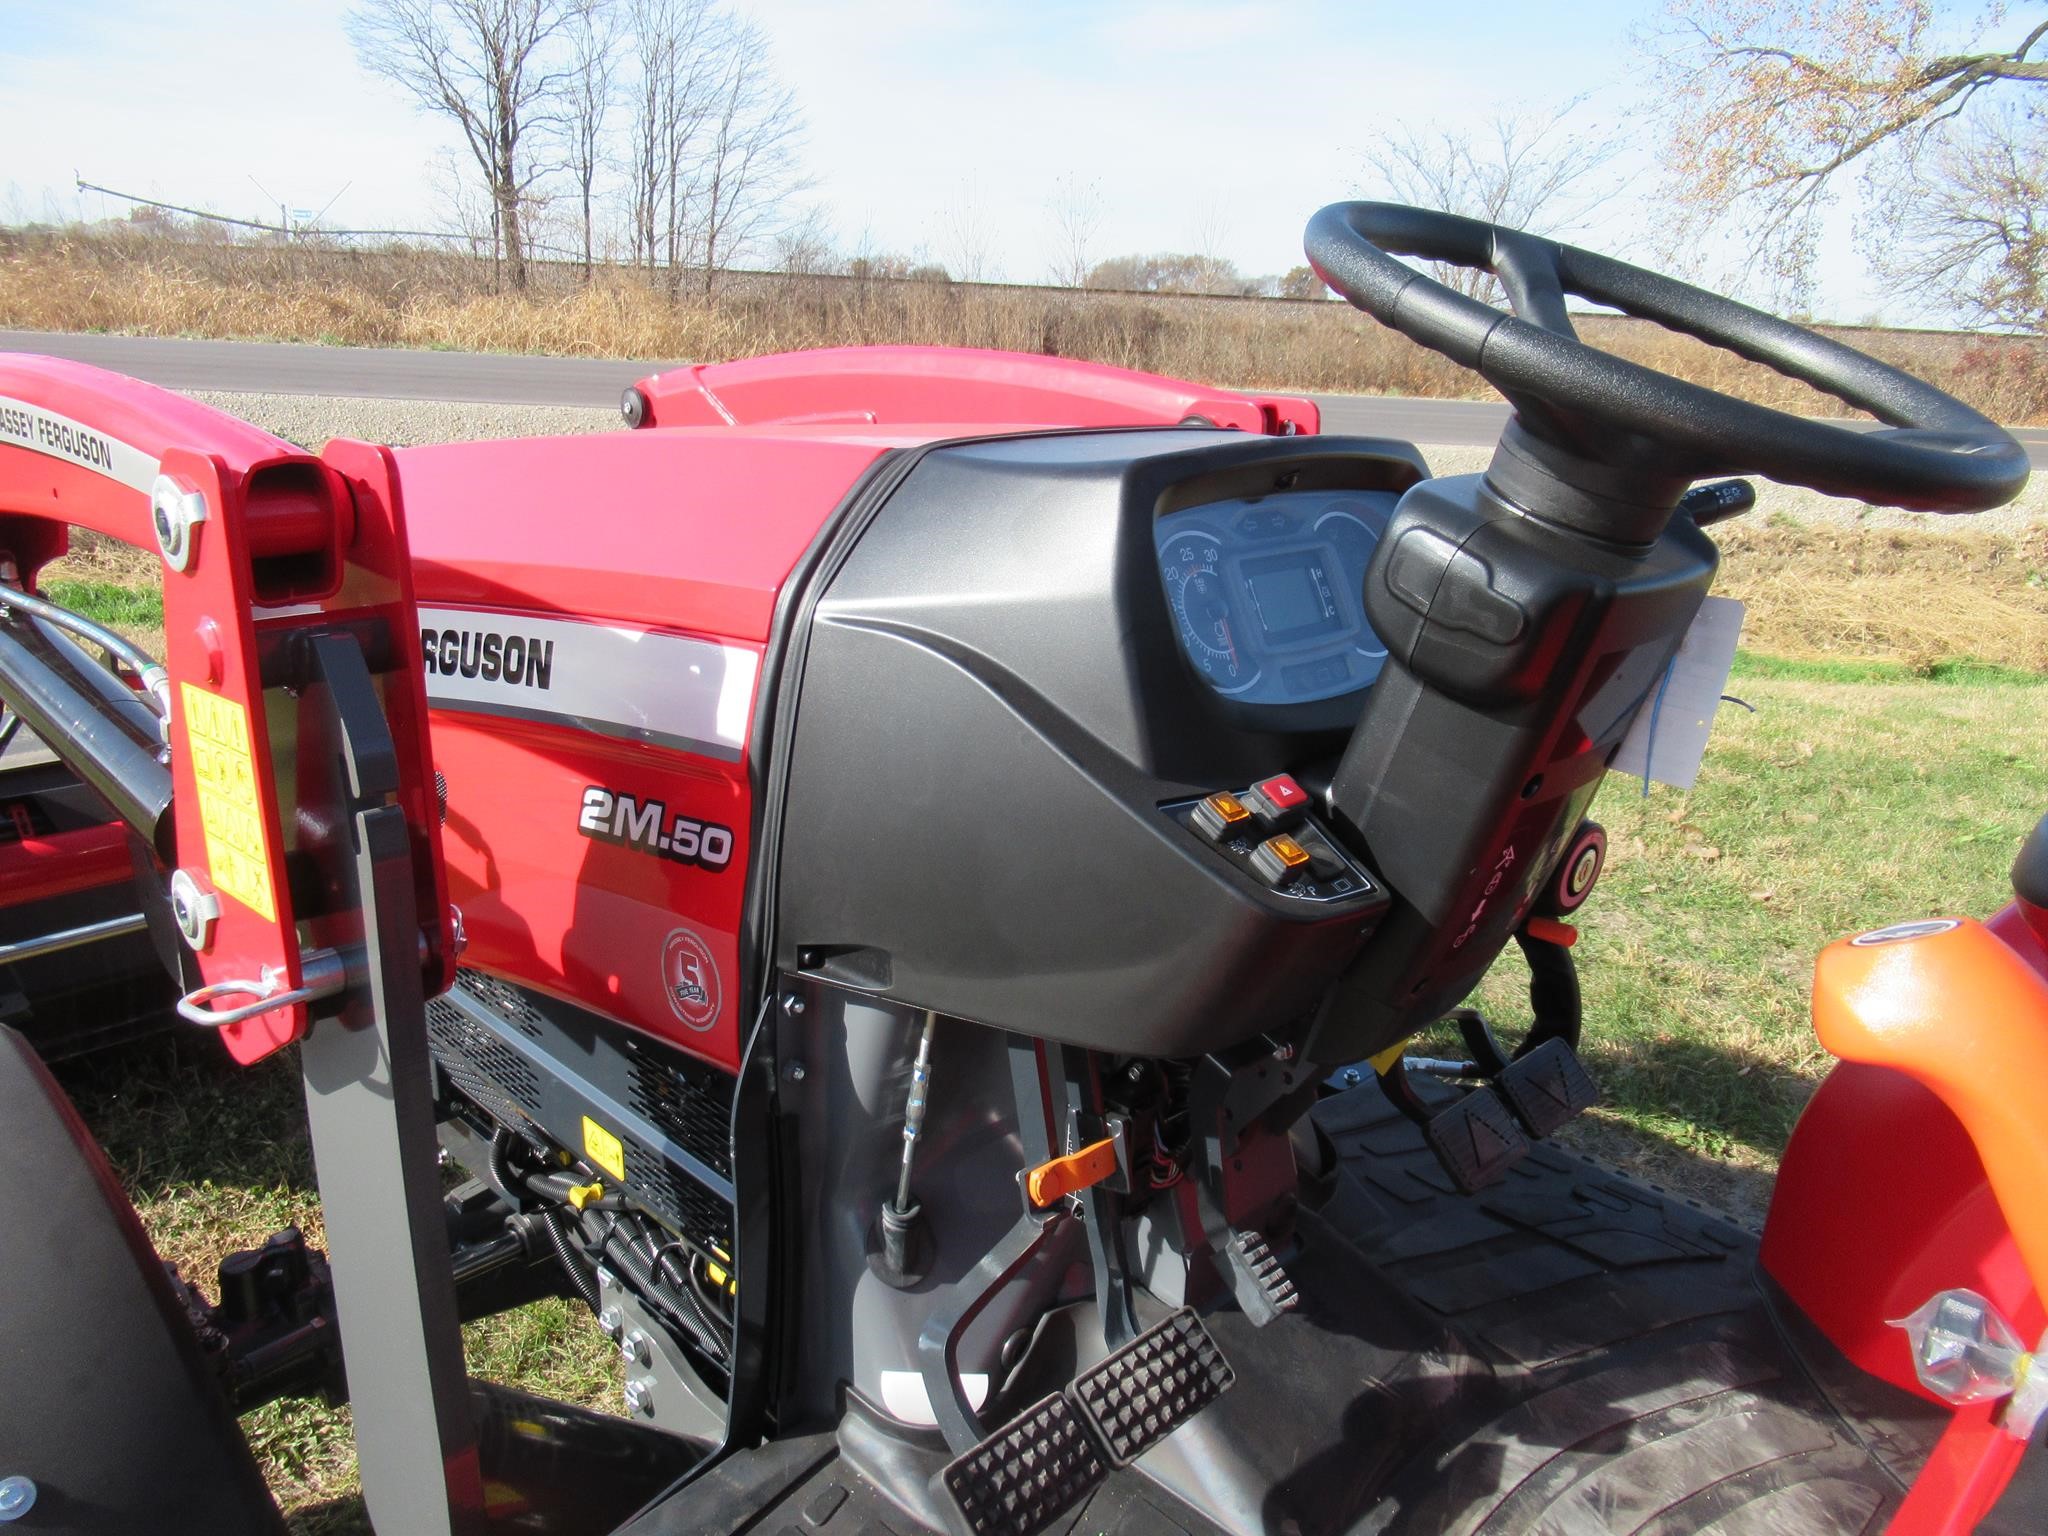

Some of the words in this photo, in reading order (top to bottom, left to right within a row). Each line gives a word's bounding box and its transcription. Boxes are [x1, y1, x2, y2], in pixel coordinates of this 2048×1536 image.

[0, 408, 33, 439] ASSEY
[38, 417, 112, 470] FERGUSON
[1180, 547, 1194, 561] 25
[1204, 548, 1218, 562] 30
[1164, 566, 1179, 580] 20
[421, 628, 554, 690] RGUSON
[1228, 664, 1237, 677] 0
[578, 785, 734, 872] 2M.50
